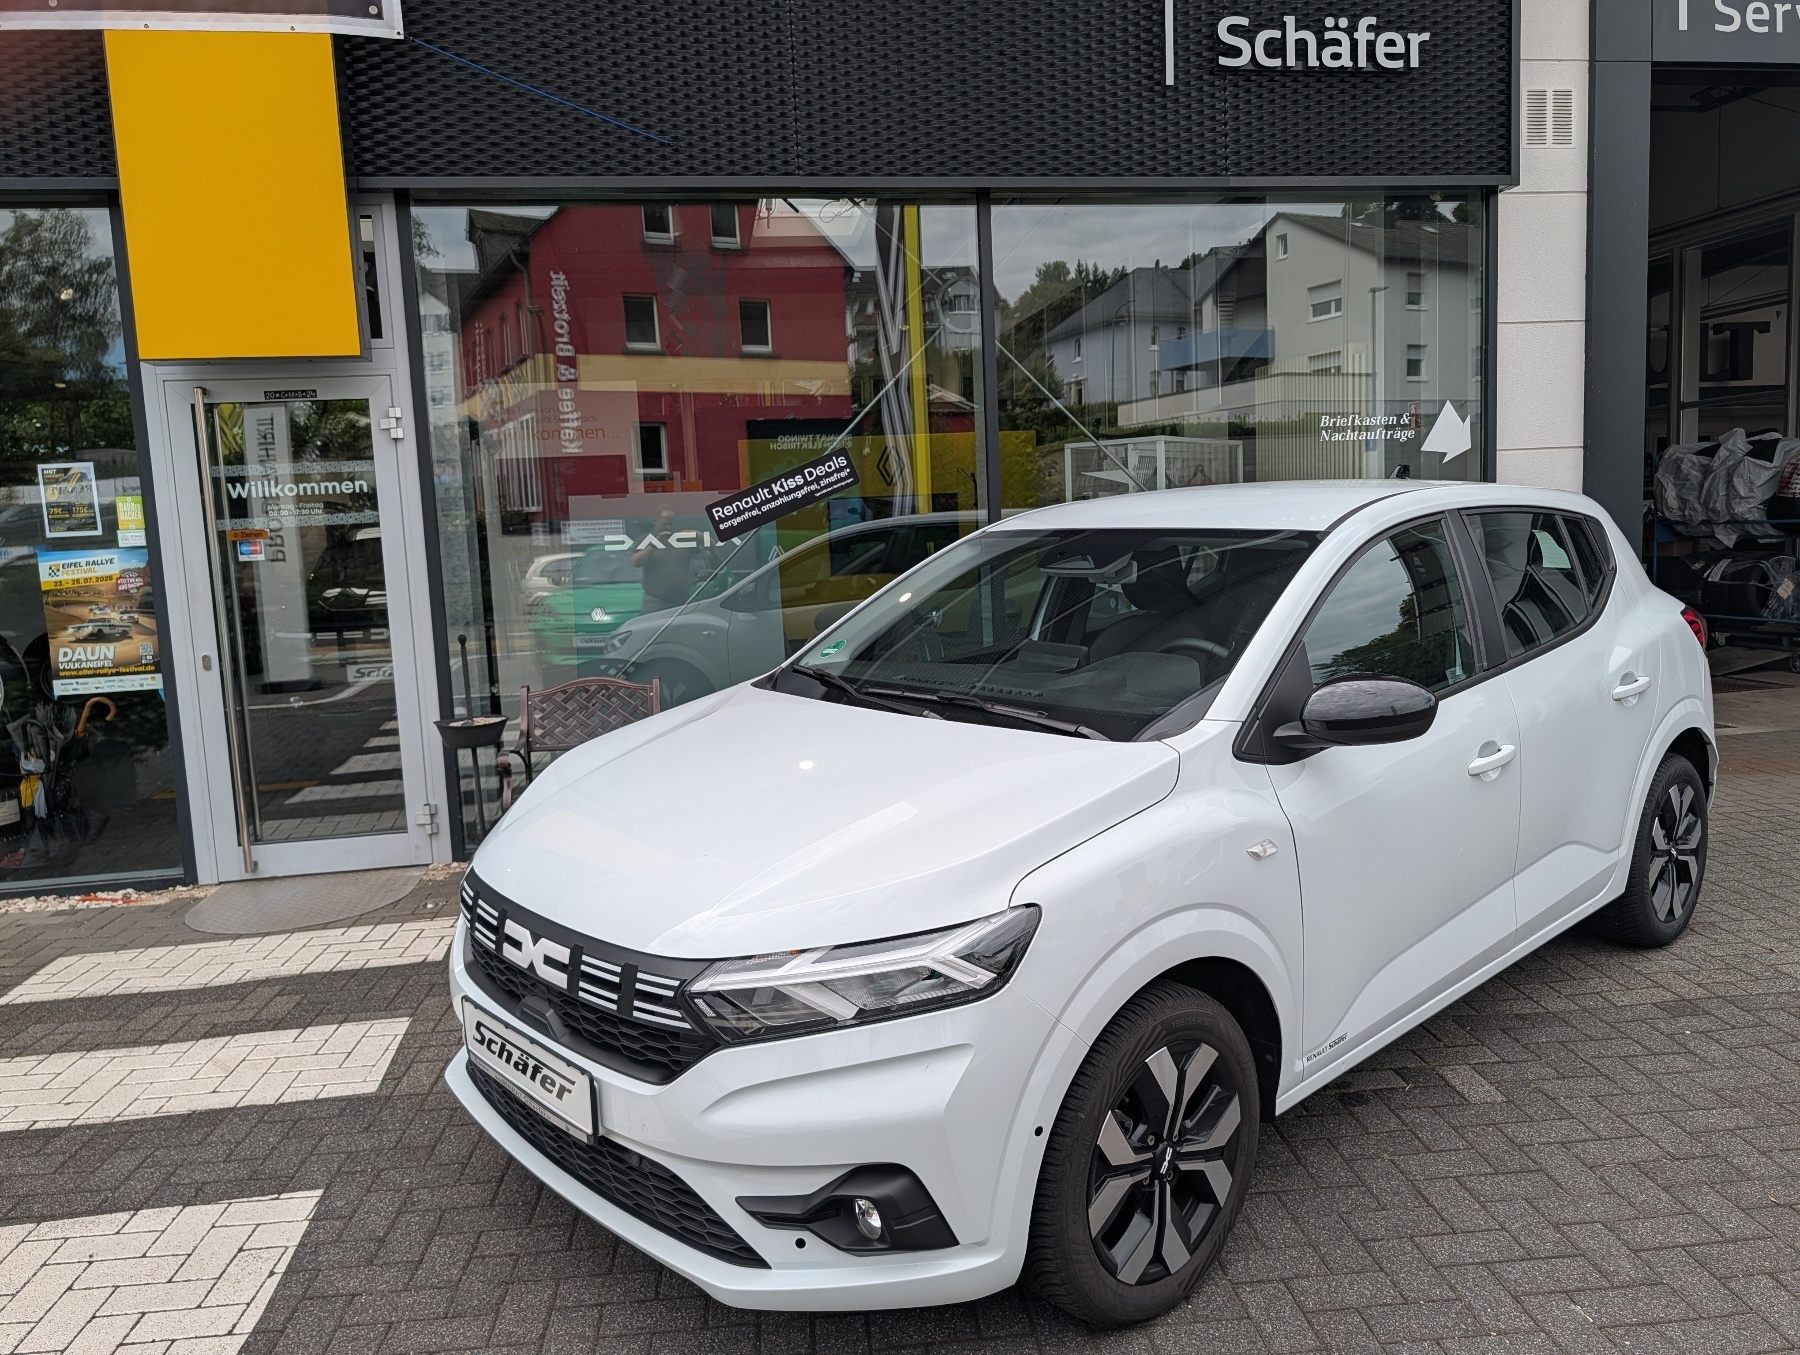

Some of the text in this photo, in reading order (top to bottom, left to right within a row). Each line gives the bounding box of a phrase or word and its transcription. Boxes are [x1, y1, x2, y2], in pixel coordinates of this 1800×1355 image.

[1714, 0, 1800, 33] Ser
[1217, 15, 1431, 69] Schäfer
[1319, 412, 1411, 427] Briefkasten &
[1319, 427, 1416, 442] Nachtaufträge
[227, 480, 368, 499] Willkommen
[712, 455, 848, 520] Renault Kiss Deals
[299, 502, 324, 510] Freitag
[719, 507, 762, 530] sorgenfrei,
[761, 483, 820, 512] anzahlungsfrei,
[61, 557, 115, 570] EIFEL RALLYE
[61, 566, 97, 577] FESTIVAL
[58, 645, 116, 662] DAUN
[59, 660, 113, 670] VULKANEIFEL
[472, 1020, 576, 1102] Schäfer
[1306, 1046, 1328, 1063] RENAULT
